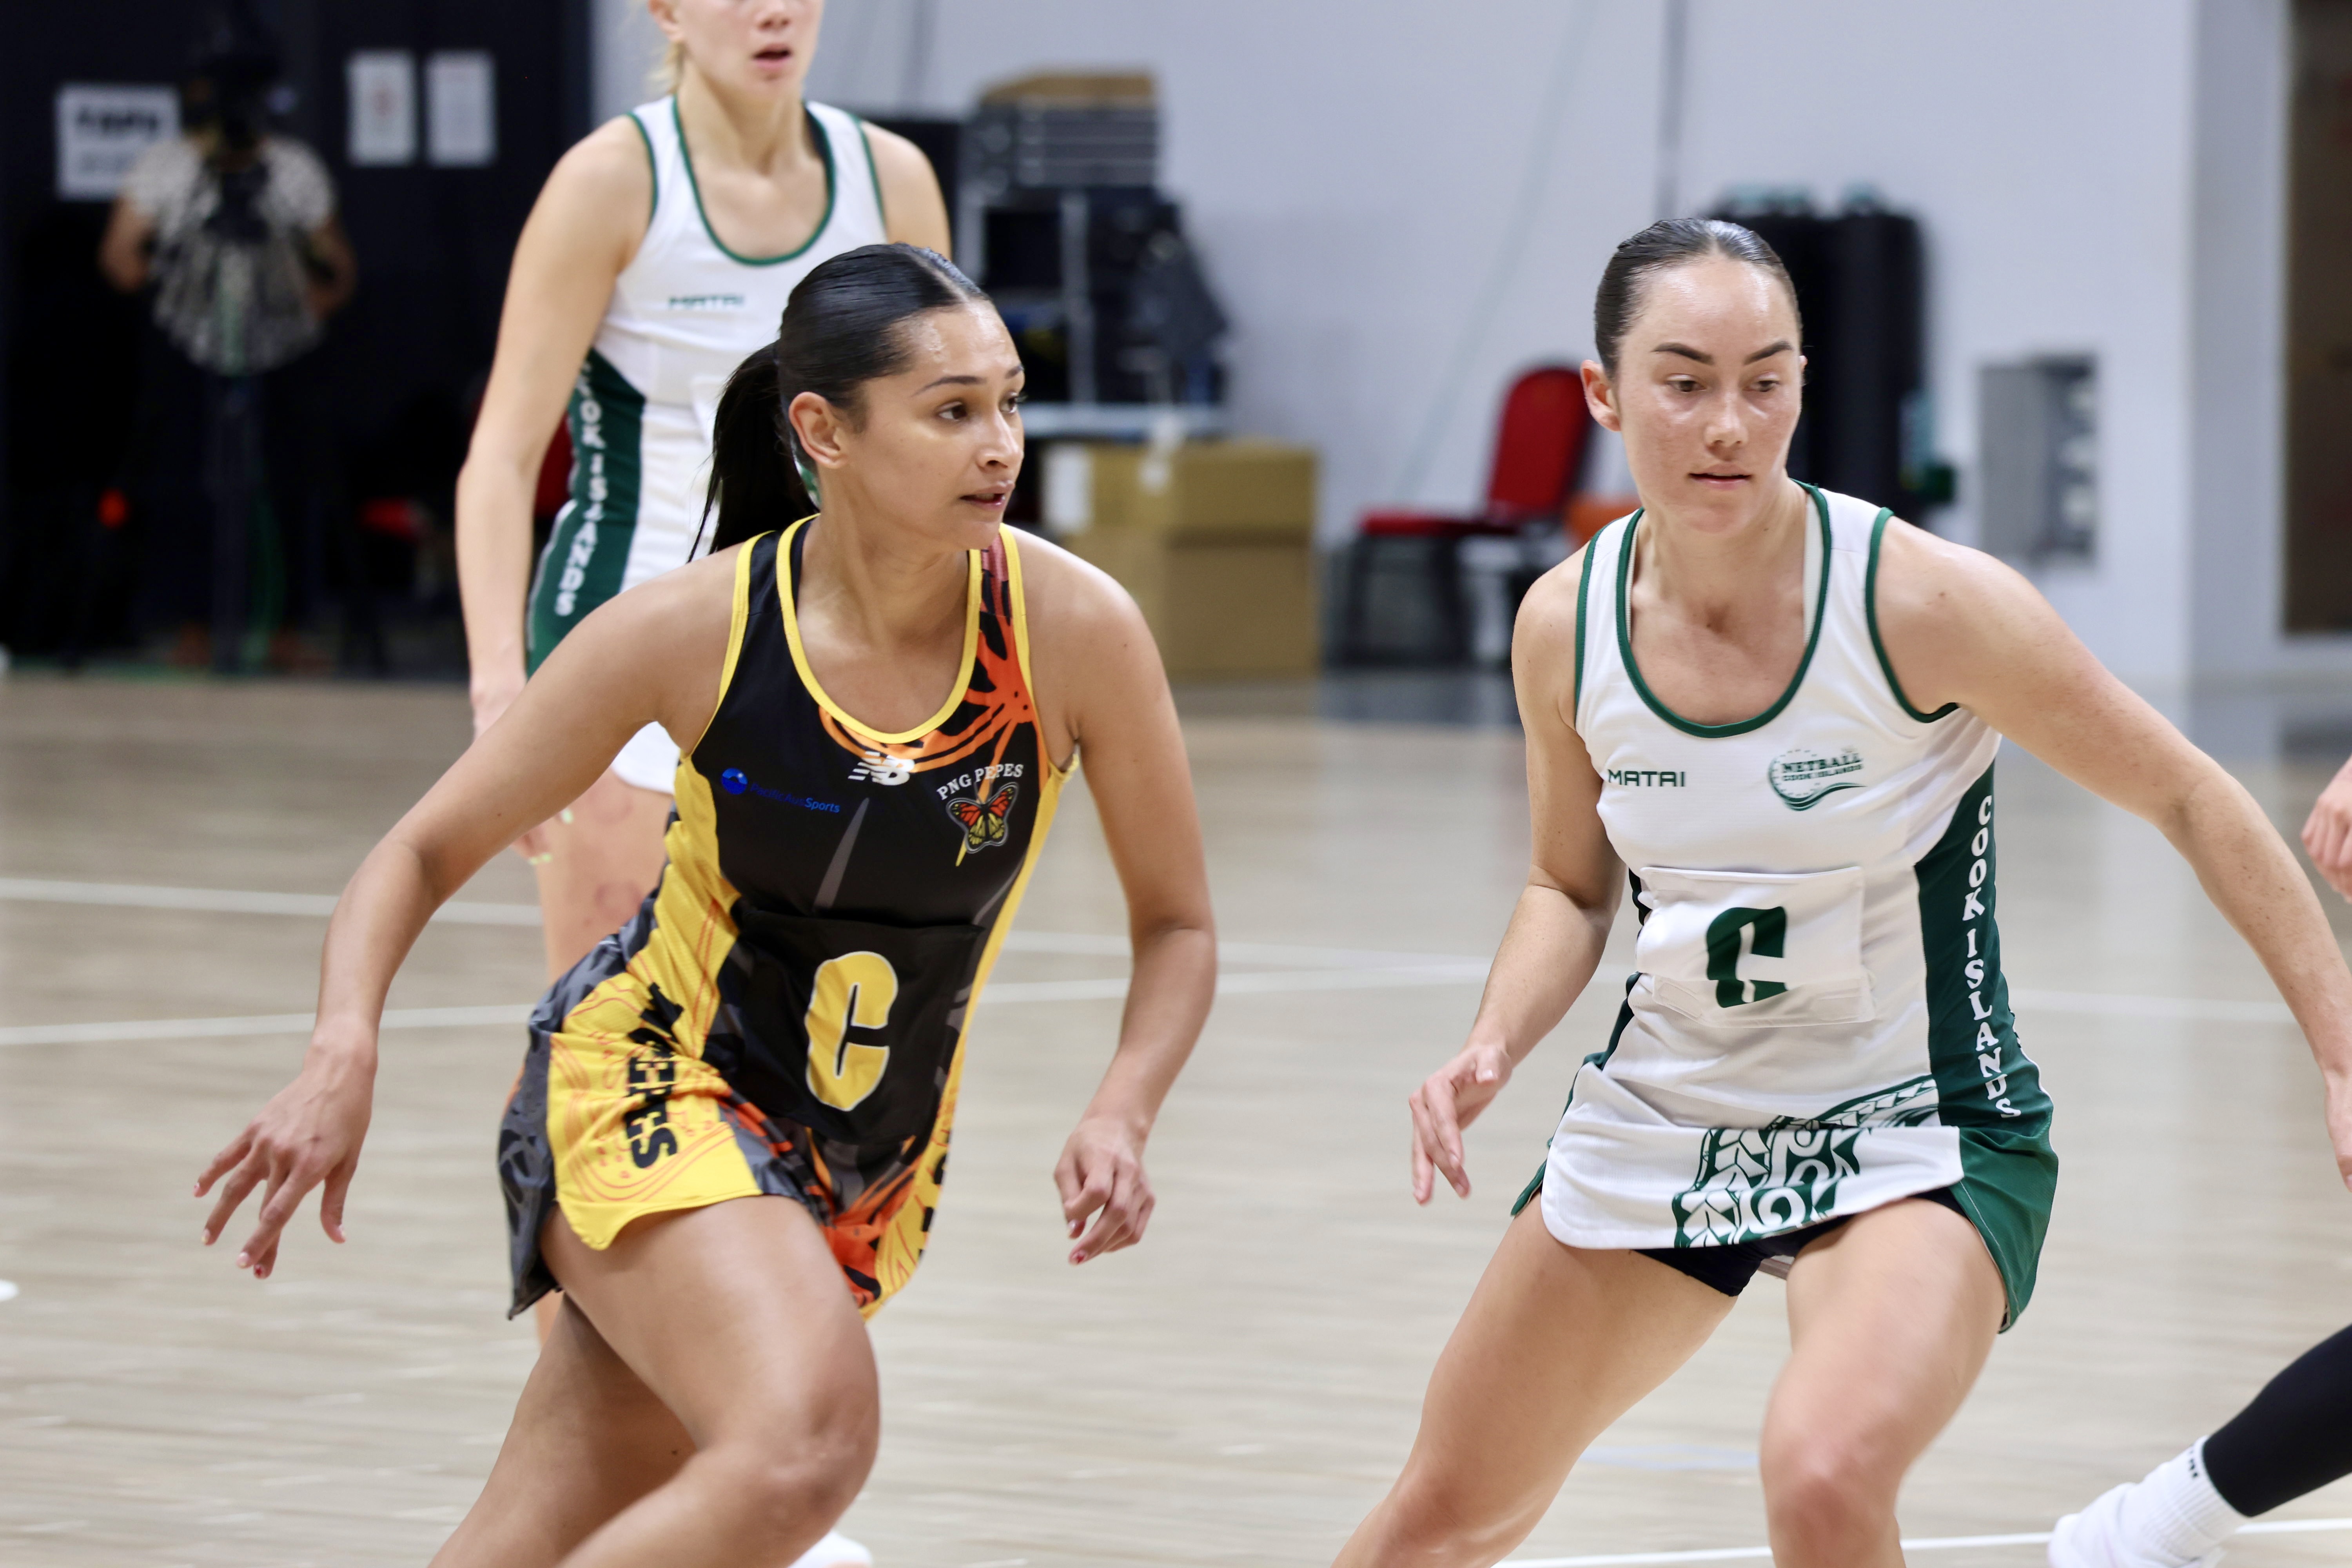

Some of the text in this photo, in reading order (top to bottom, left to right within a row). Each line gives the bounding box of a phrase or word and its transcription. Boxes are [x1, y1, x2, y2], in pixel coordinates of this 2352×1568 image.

[936, 763, 1024, 800] PNG PEPES
[1608, 769, 1686, 787] MATAI
[1781, 753, 1863, 773] NETBALL
[1706, 906, 1788, 1008] C
[1962, 795, 2022, 1118] COOK ISLANDS
[805, 951, 898, 1111] C
